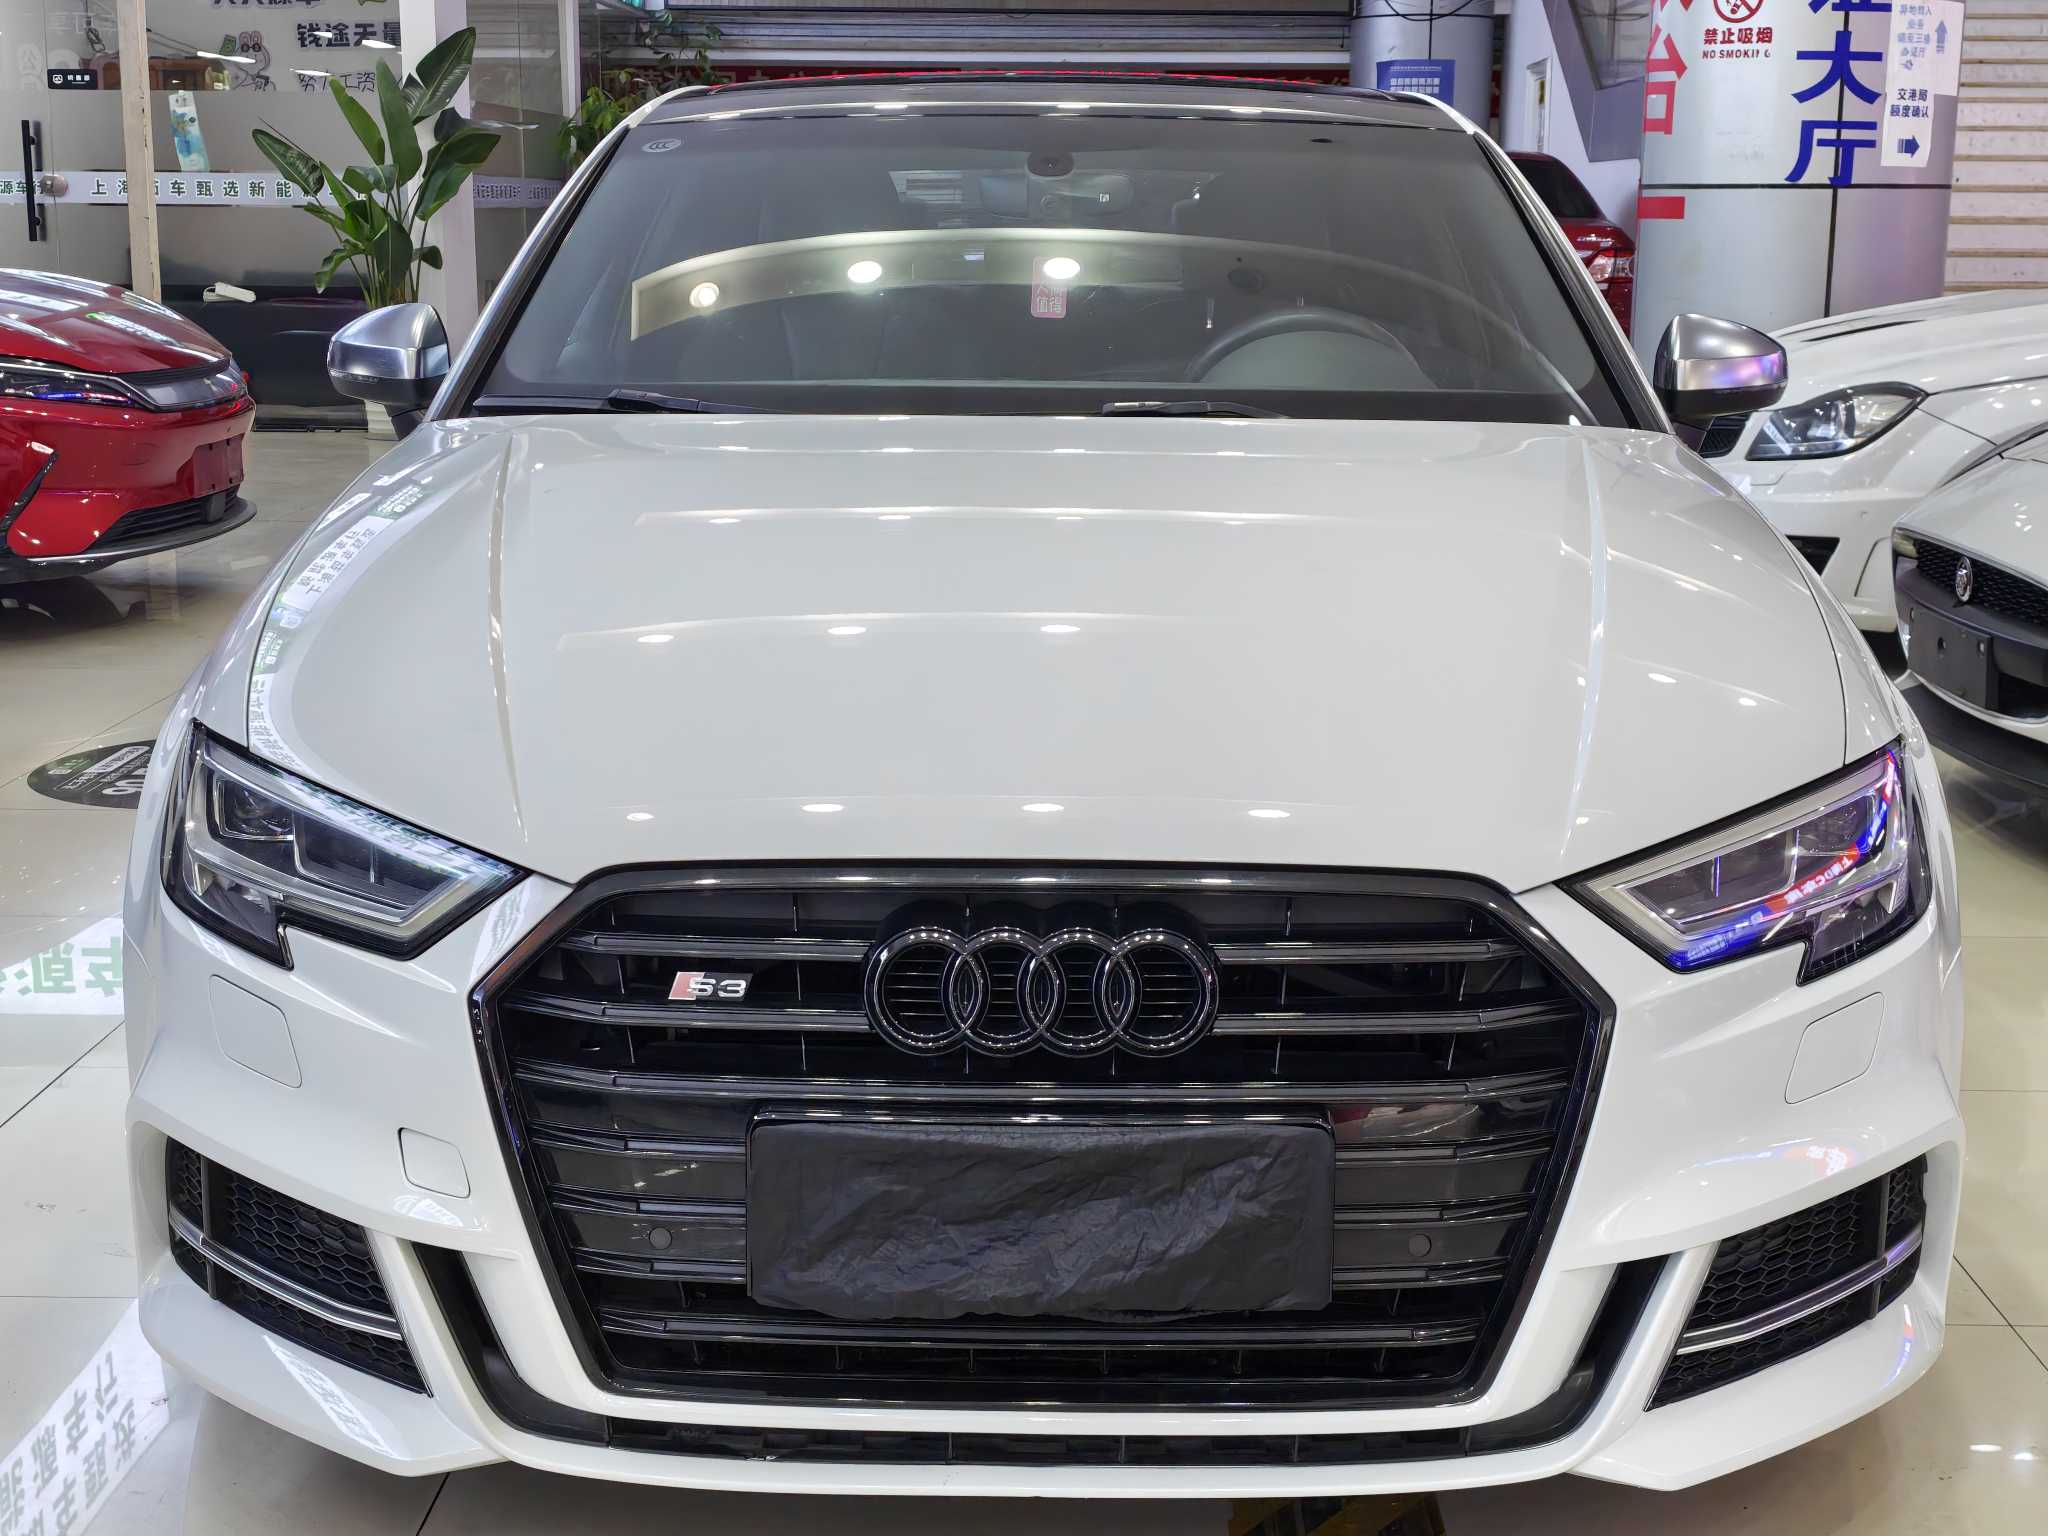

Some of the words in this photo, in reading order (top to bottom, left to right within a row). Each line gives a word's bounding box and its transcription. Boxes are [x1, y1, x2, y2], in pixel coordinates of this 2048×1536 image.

[1703, 27, 1773, 45] 禁止吸烟
[1702, 50, 1716, 59] NO
[1644, 0, 1694, 135] 台
[1784, 0, 1892, 188] 大厅
[687, 977, 747, 998] S3
